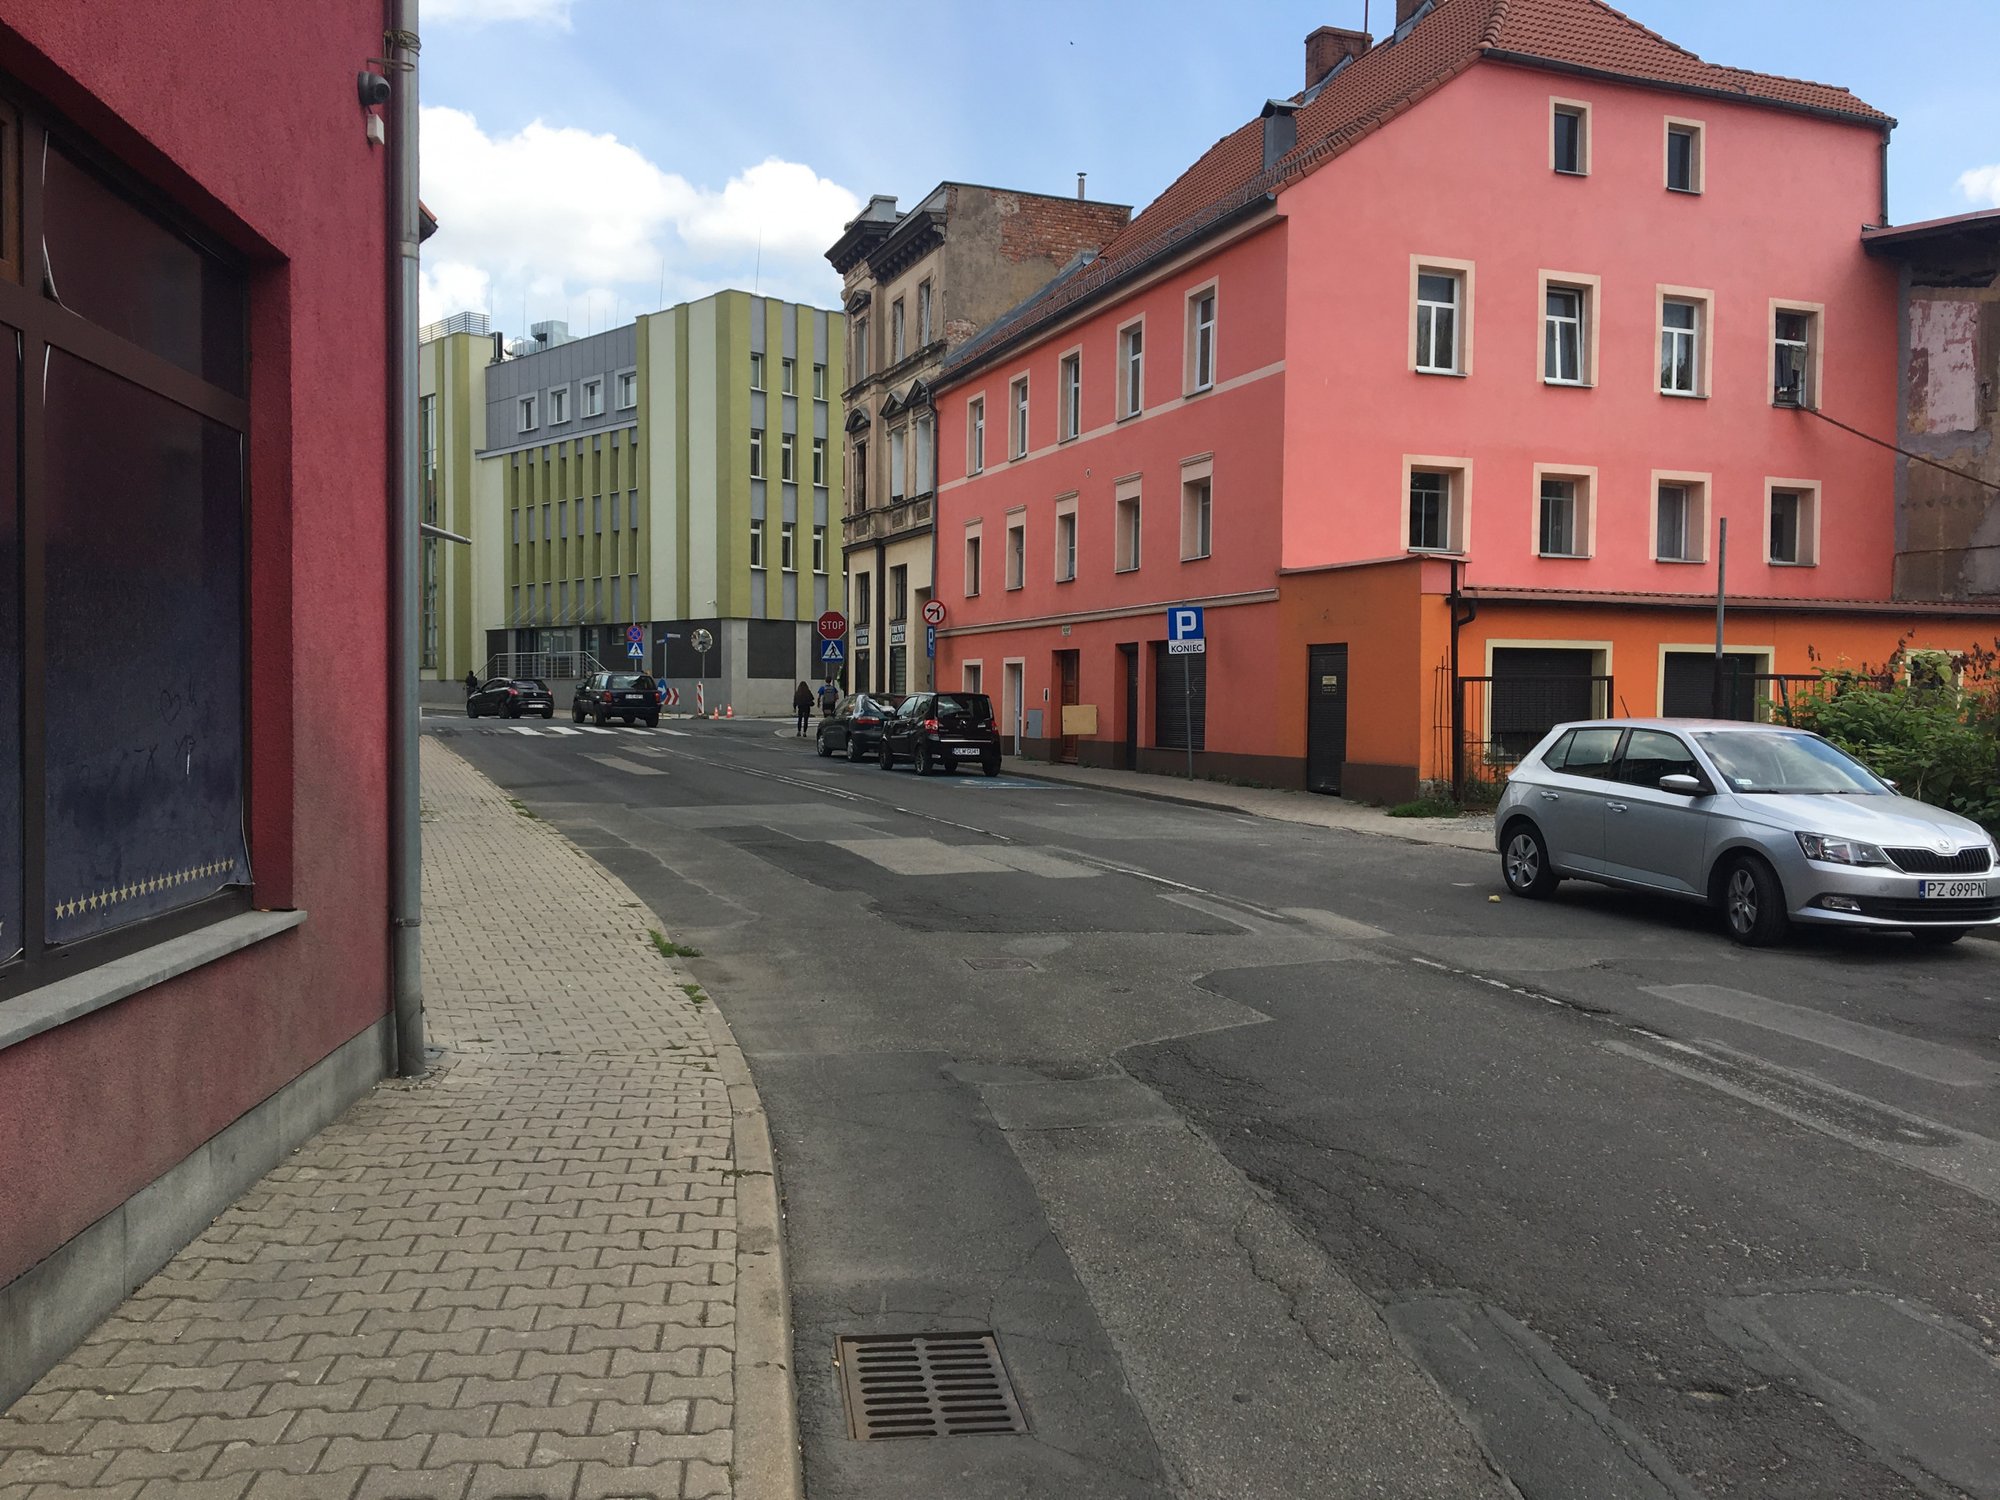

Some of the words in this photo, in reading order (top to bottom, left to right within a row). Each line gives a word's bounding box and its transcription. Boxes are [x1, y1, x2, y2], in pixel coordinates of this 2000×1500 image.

[821, 621, 844, 630] STOP
[1176, 611, 1197, 640] P
[1171, 644, 1203, 653] KONIEC
[1927, 882, 1946, 897] PZ
[1949, 882, 1985, 897] 699PN
